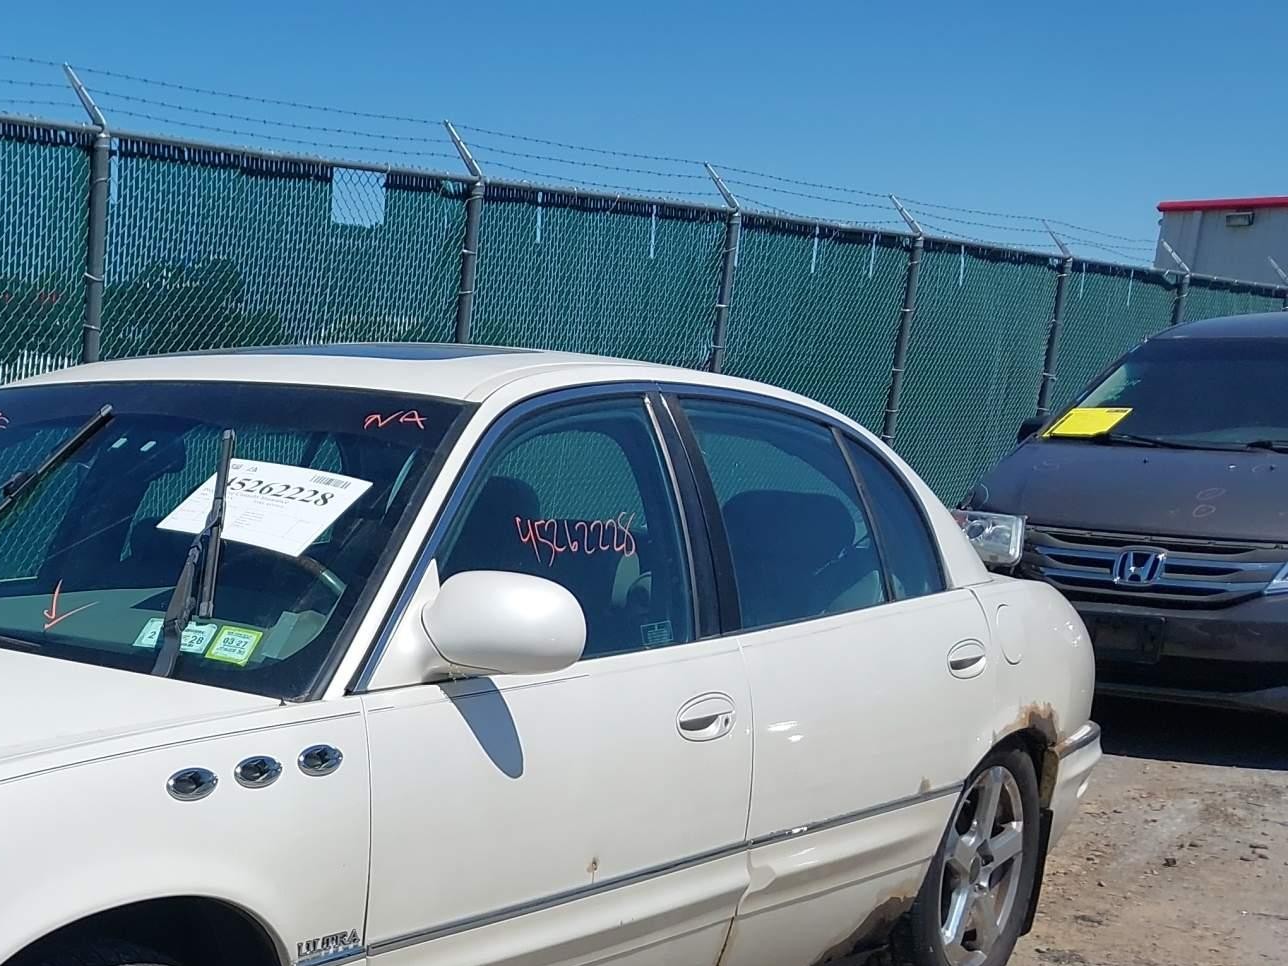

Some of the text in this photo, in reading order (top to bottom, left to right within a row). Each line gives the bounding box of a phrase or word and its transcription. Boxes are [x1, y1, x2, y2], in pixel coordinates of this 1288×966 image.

[515, 512, 636, 567] 45262228
[188, 635, 204, 645] 28
[222, 637, 248, 648] 03 27
